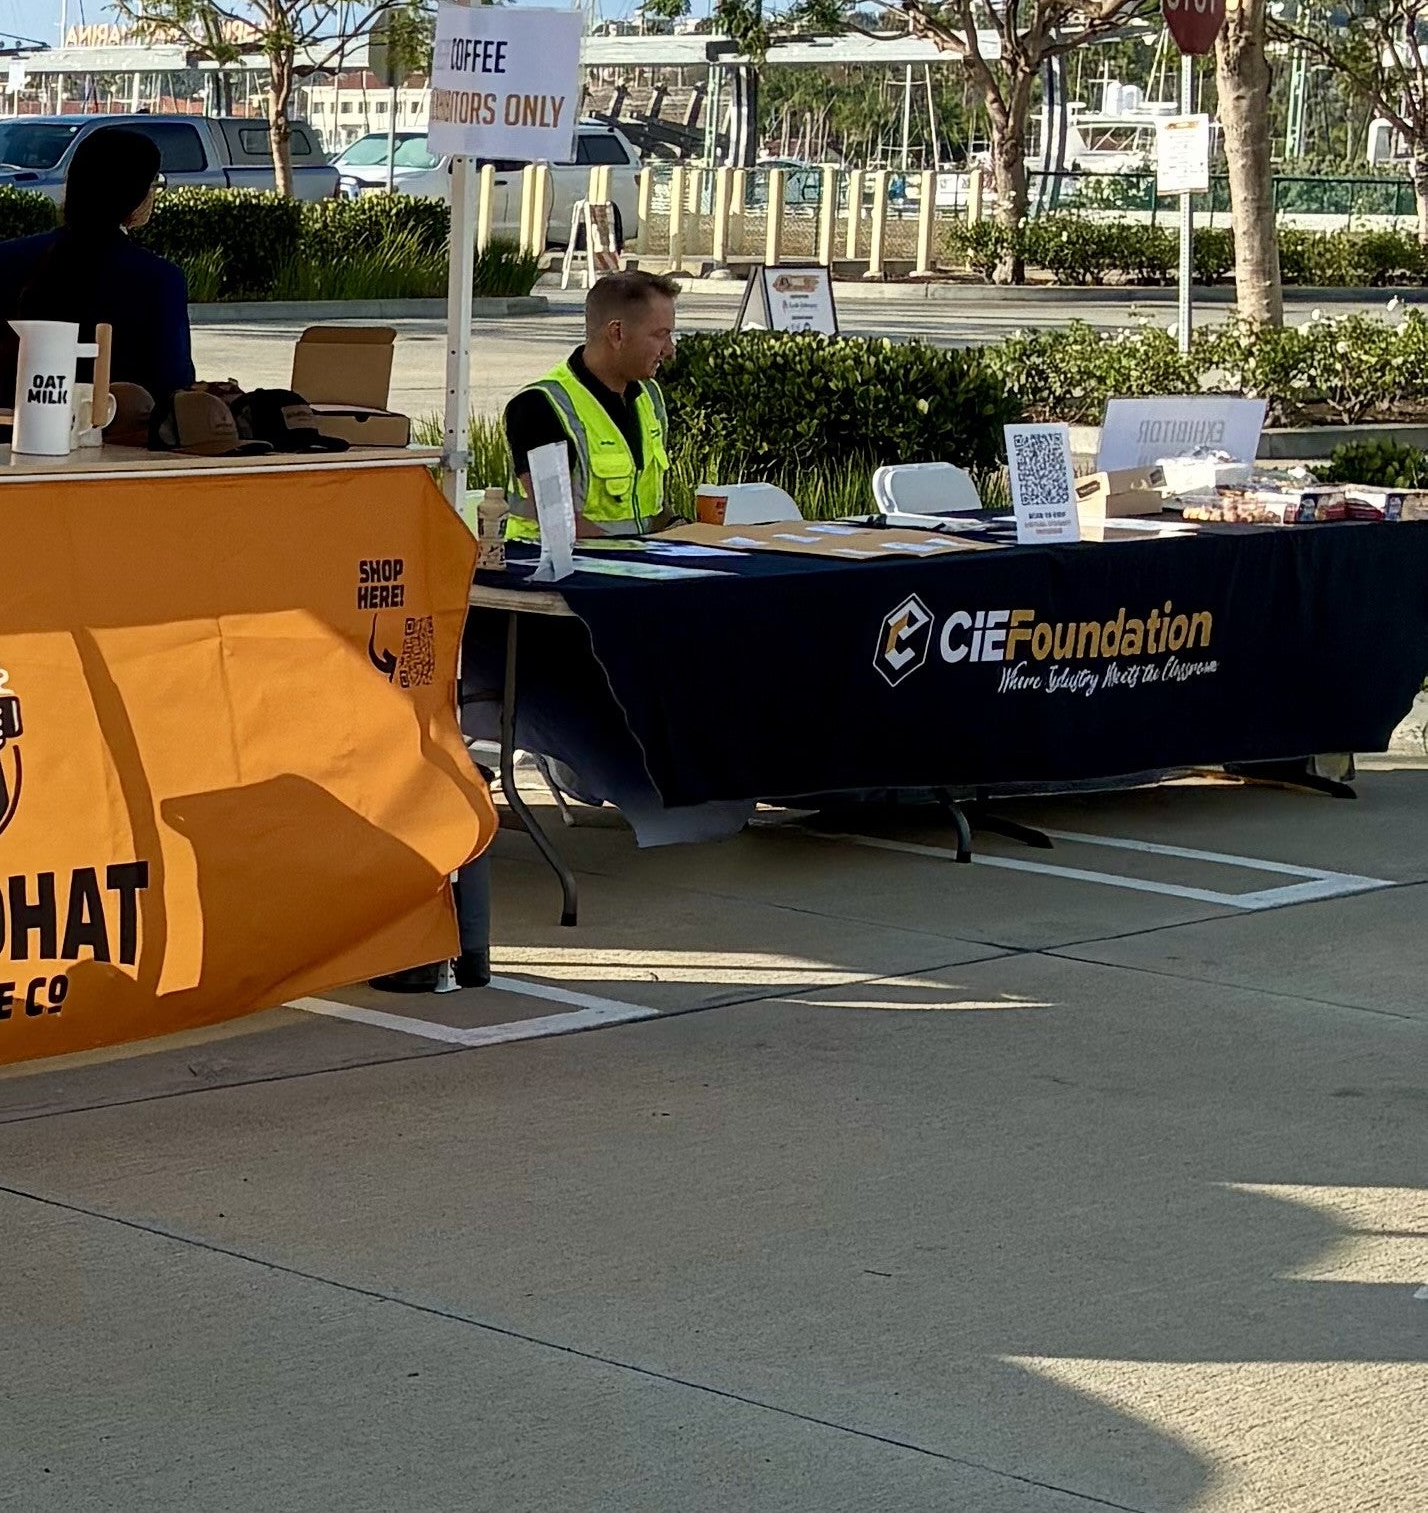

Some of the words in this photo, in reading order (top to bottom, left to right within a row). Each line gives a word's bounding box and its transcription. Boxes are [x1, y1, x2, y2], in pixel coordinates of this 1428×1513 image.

[504, 93, 566, 128] ONLY
[33, 374, 67, 389] OAT
[27, 389, 68, 404] MILK
[358, 558, 404, 584] SHOP
[357, 584, 405, 610] HERE!
[998, 660, 1044, 694] Where
[1101, 661, 1142, 689] Meets
